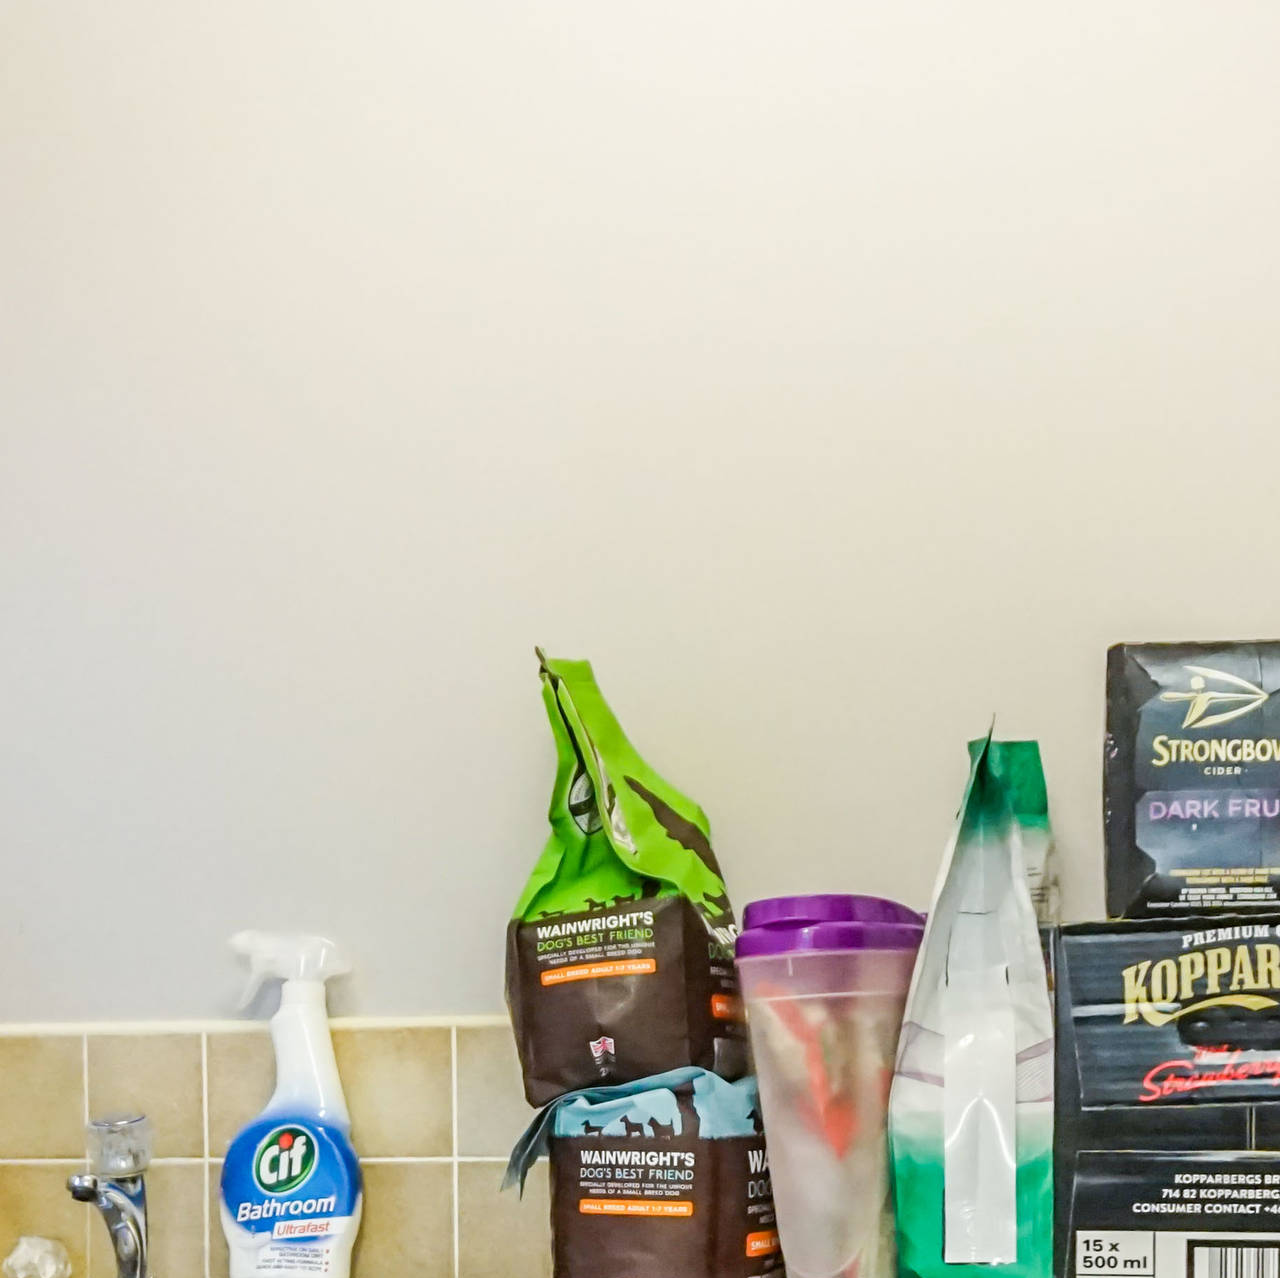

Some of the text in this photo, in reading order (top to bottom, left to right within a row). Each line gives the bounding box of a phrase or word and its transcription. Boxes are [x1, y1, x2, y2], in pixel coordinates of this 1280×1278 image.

[1203, 766, 1242, 776] CIDER
[1149, 800, 1219, 821] DARK
[536, 911, 654, 939] WAINWRIGHT'S
[536, 928, 654, 952] DOG'S BEST FRIEND
[1182, 925, 1269, 948] PREMIUM
[259, 1132, 307, 1185] Cif
[580, 1150, 696, 1167] WAINWRIGHT'S
[580, 1167, 694, 1181] DOG'S BEST FRIEND
[1174, 1174, 1262, 1185] KOPPARBERGS
[1162, 1188, 1181, 1199] 714
[1182, 1189, 1197, 1199] 82
[236, 1195, 337, 1223] Bathroom
[1132, 1203, 1201, 1214] CONSUMER
[1204, 1203, 1262, 1214] CONTACT
[276, 1220, 331, 1237] Ultrafast
[1083, 1240, 1120, 1253] 15 x
[1082, 1256, 1148, 1269] 500 ml
